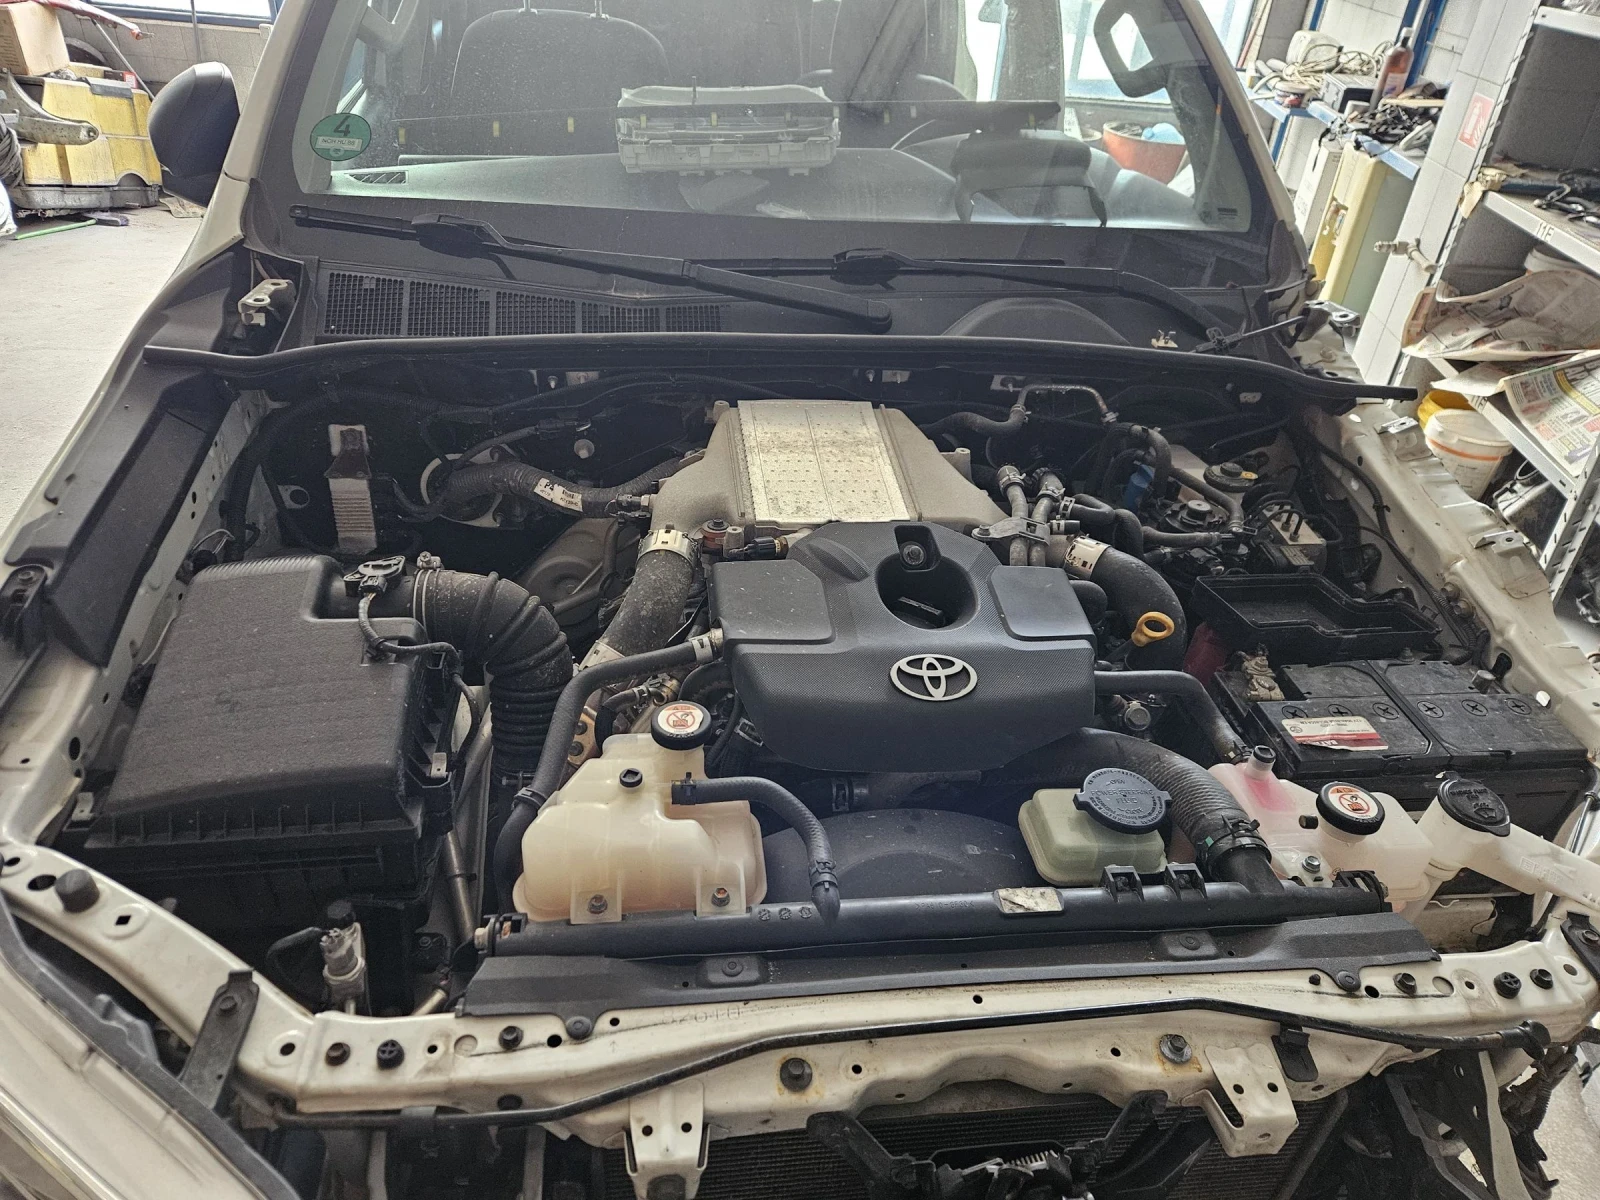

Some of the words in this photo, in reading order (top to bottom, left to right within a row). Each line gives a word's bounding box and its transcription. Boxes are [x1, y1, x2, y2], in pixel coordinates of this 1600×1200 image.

[333, 115, 351, 137] 4
[1090, 788, 1118, 796] POWER
[1118, 788, 1154, 796] STEERING
